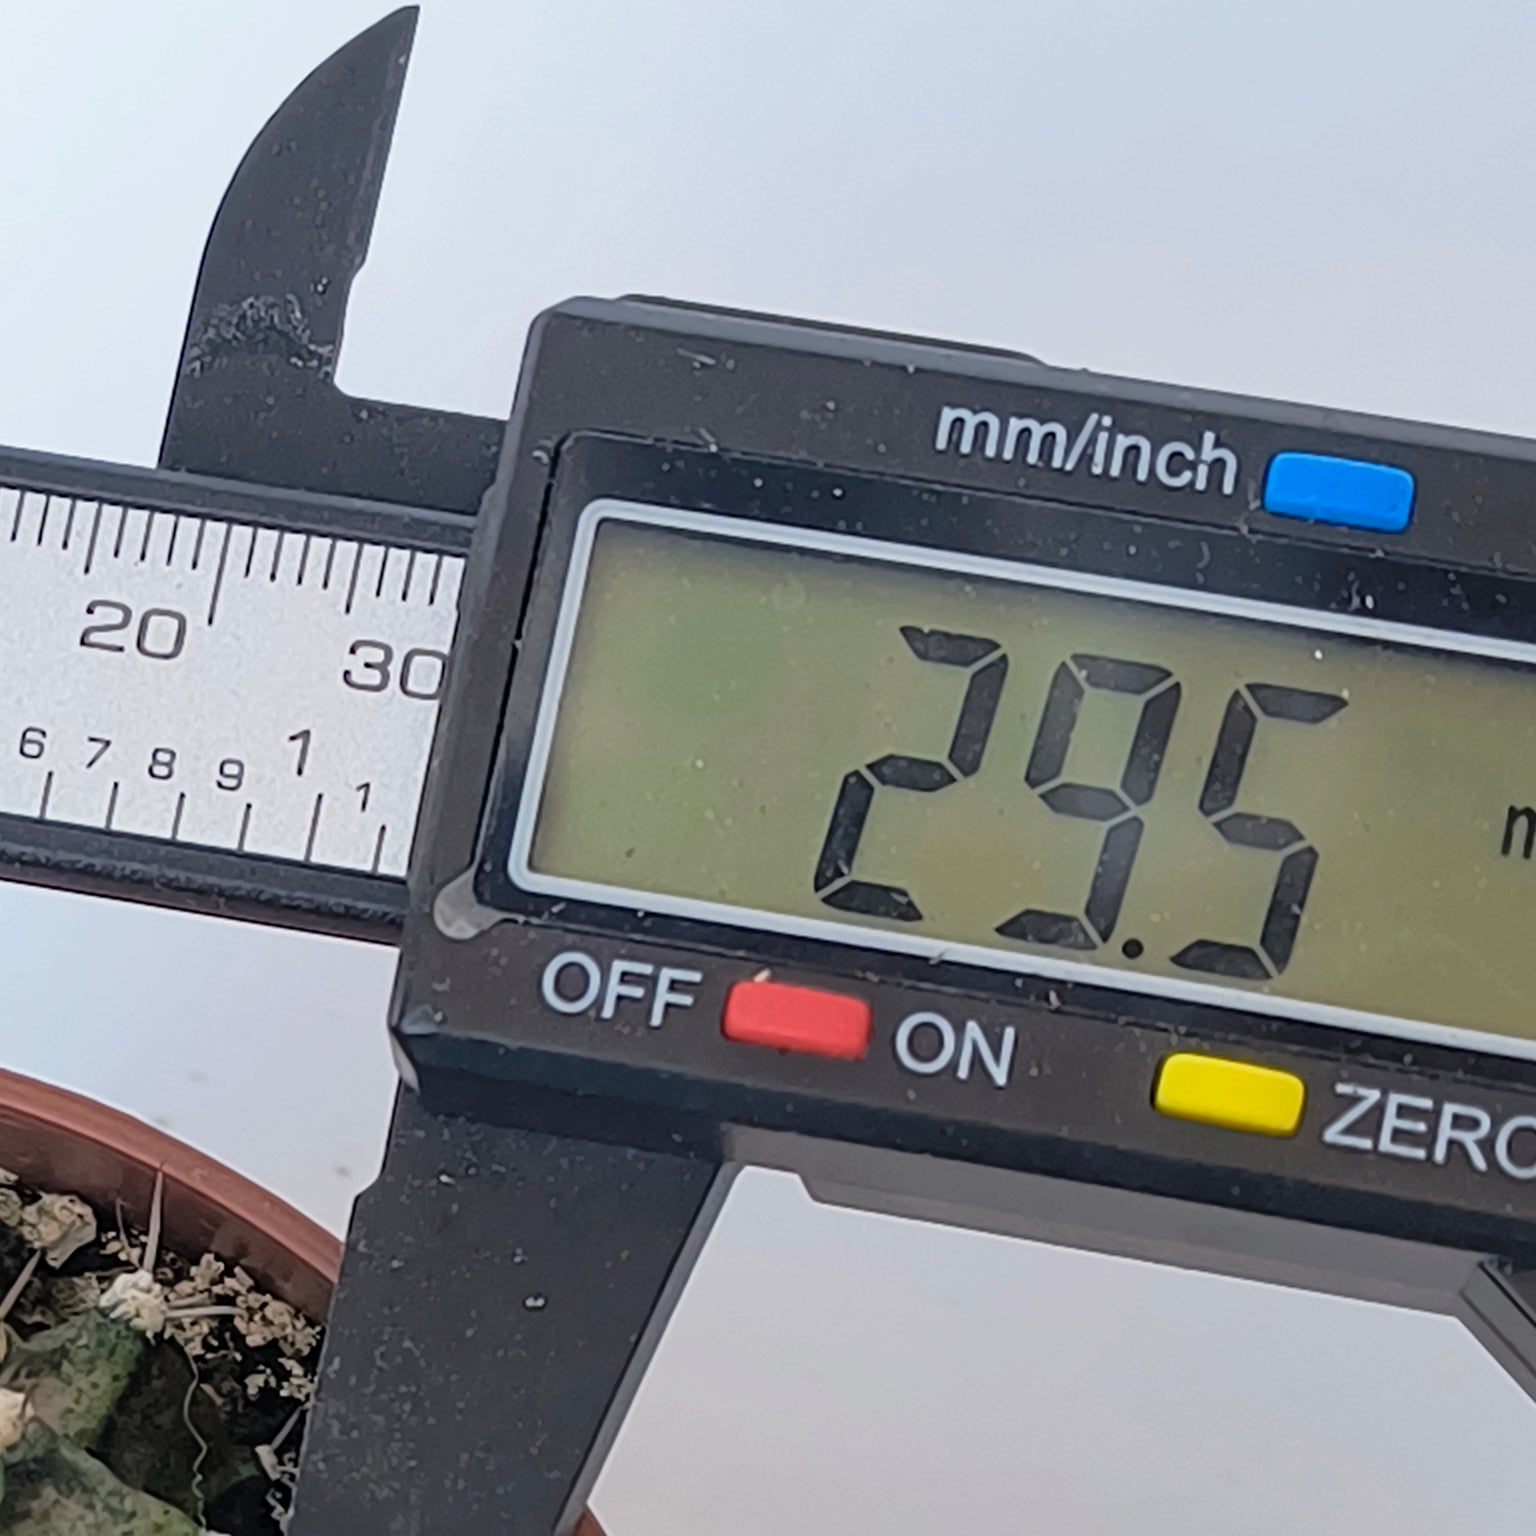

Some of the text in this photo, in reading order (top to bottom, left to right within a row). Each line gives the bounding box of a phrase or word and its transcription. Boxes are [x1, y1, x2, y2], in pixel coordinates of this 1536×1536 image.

[934, 405, 1238, 496] mm/inch
[79, 599, 187, 662] 20
[342, 639, 449, 701] 30
[18, 726, 47, 760] 6
[86, 736, 112, 769] 7
[147, 747, 176, 781] 8
[215, 758, 245, 792] 9
[288, 729, 311, 776] 1
[355, 781, 371, 813] 1
[813, 625, 1350, 980] 29.5
[541, 950, 1016, 1087] OFF ON
